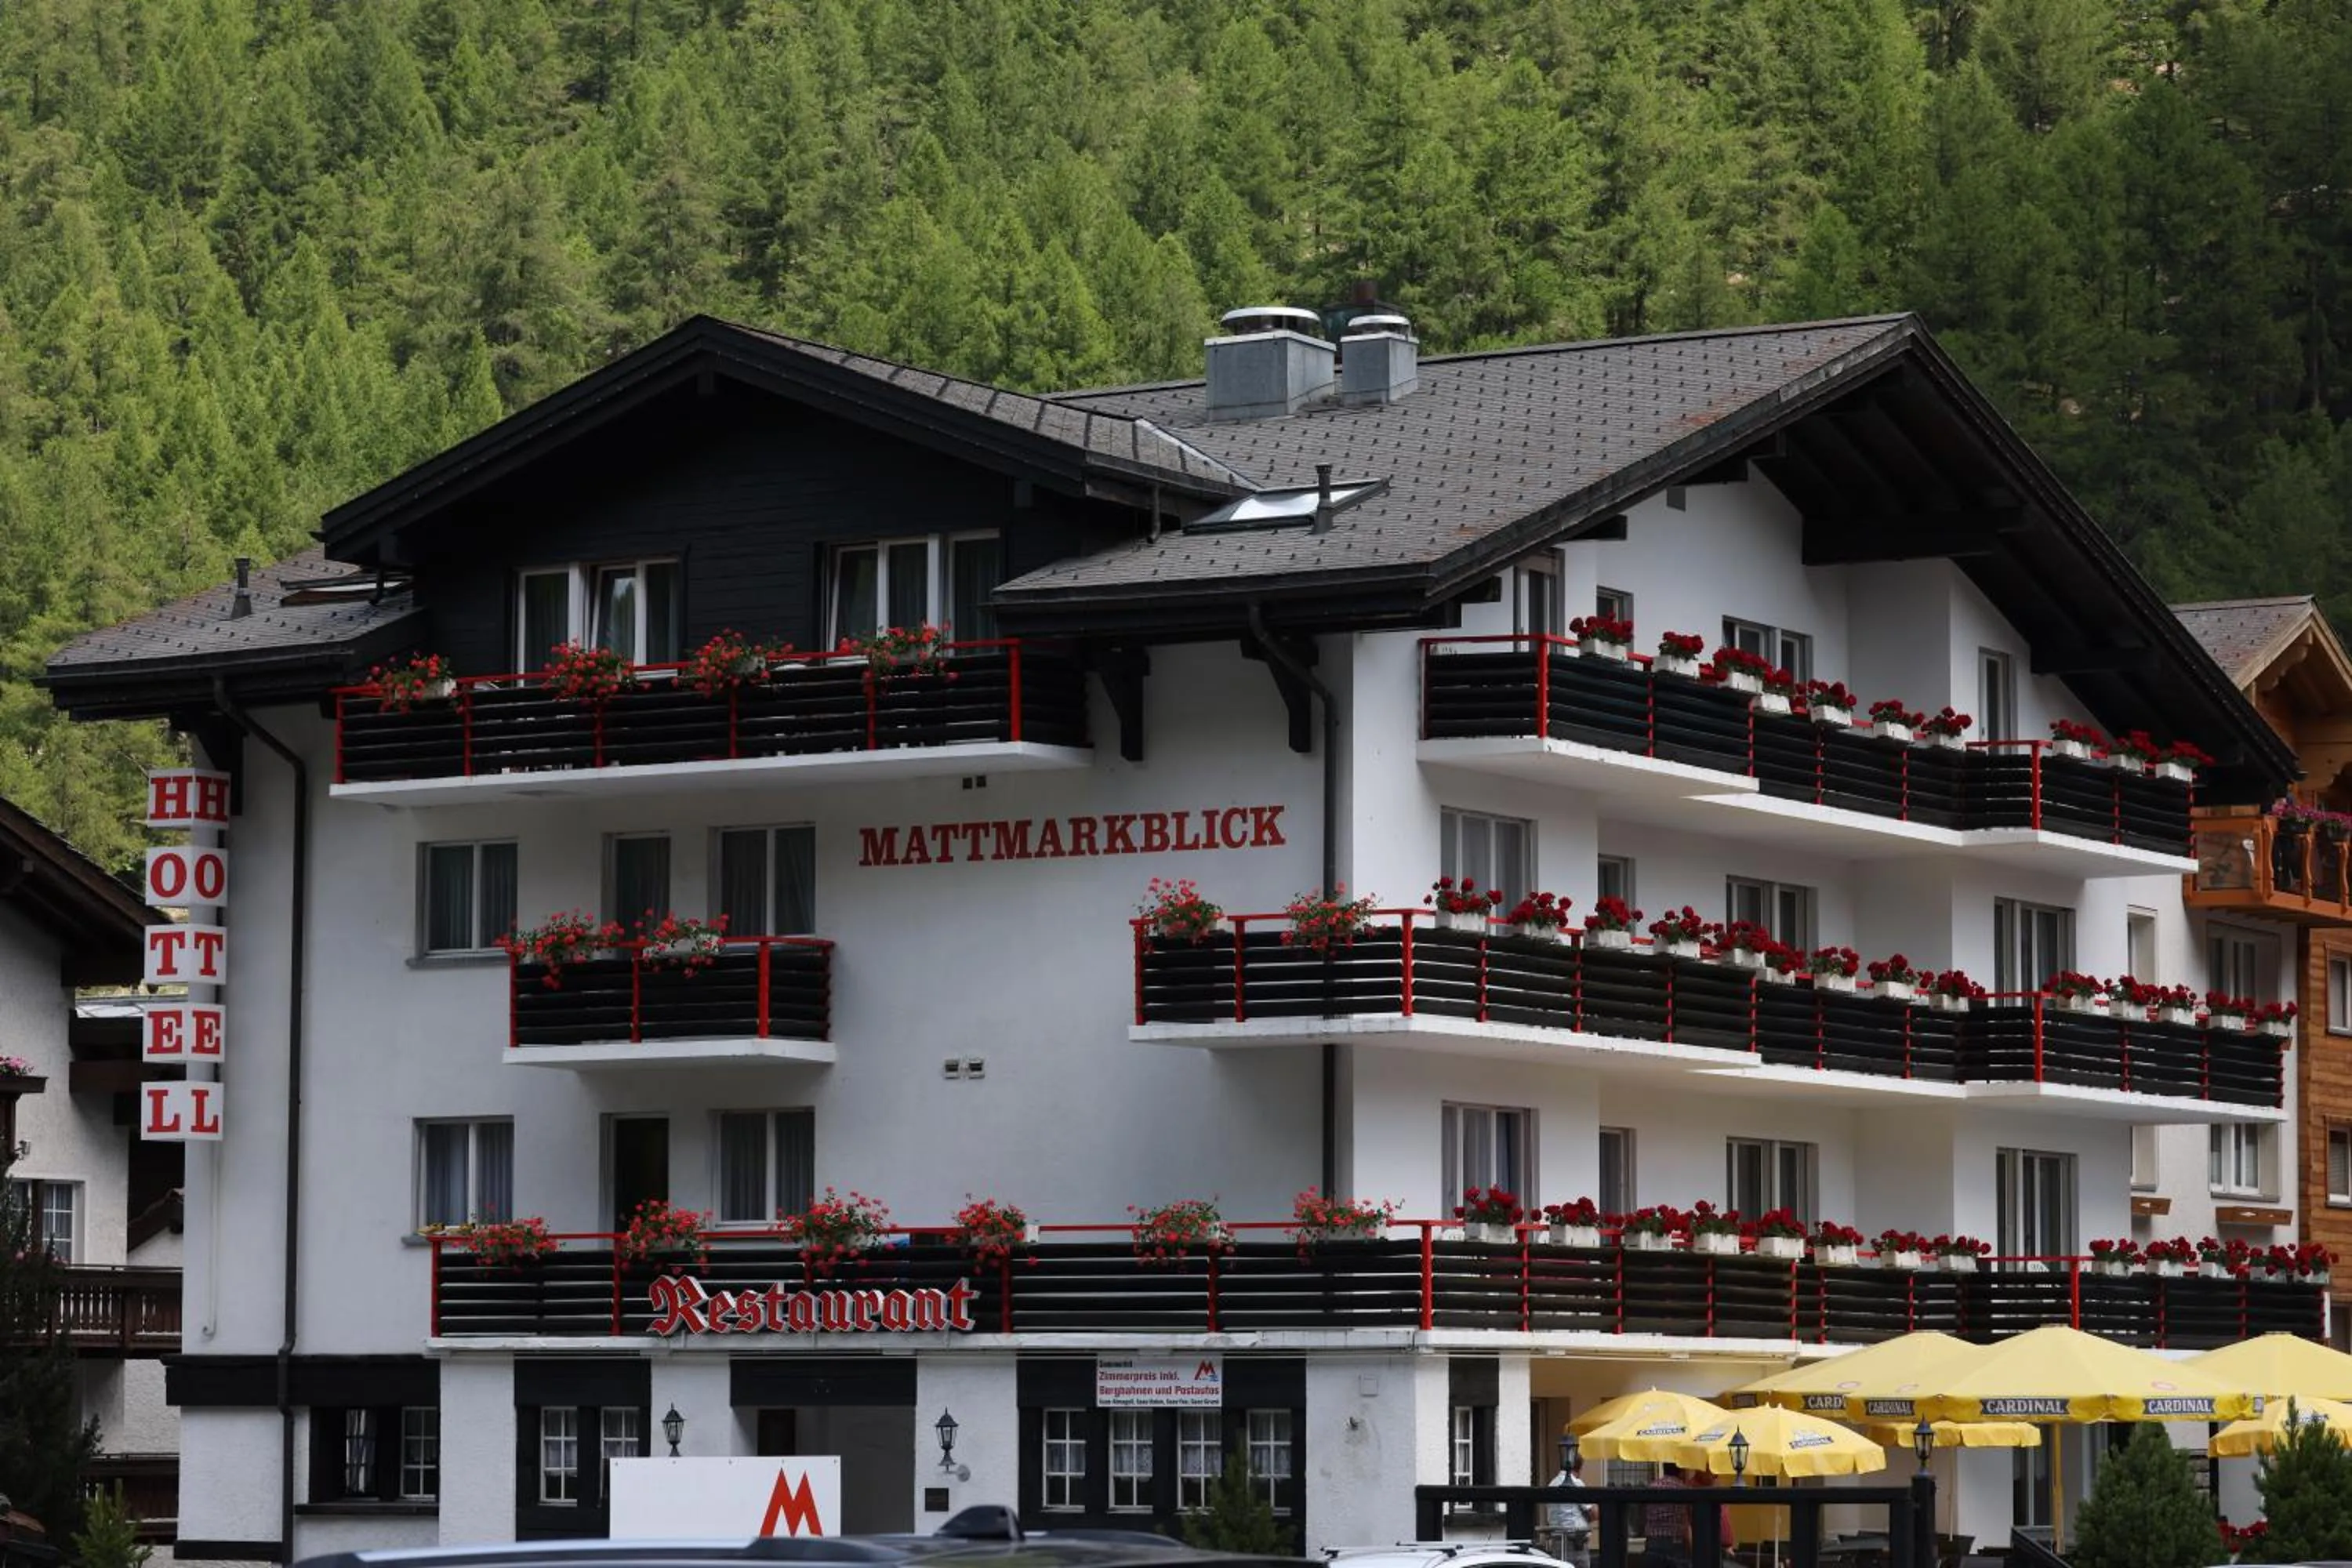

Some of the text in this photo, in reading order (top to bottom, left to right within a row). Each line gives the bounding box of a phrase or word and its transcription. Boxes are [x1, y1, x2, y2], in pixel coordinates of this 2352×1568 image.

[859, 805, 1286, 866] MATTMARKBLICK
[147, 777, 191, 1133] HOTEL
[191, 777, 230, 1134] HOTEL
[647, 1275, 981, 1334] Restaurant
[1156, 1385, 1172, 1395] und
[1986, 1398, 2065, 1414] CARDINAL
[2148, 1398, 2212, 1414] CARDINAL
